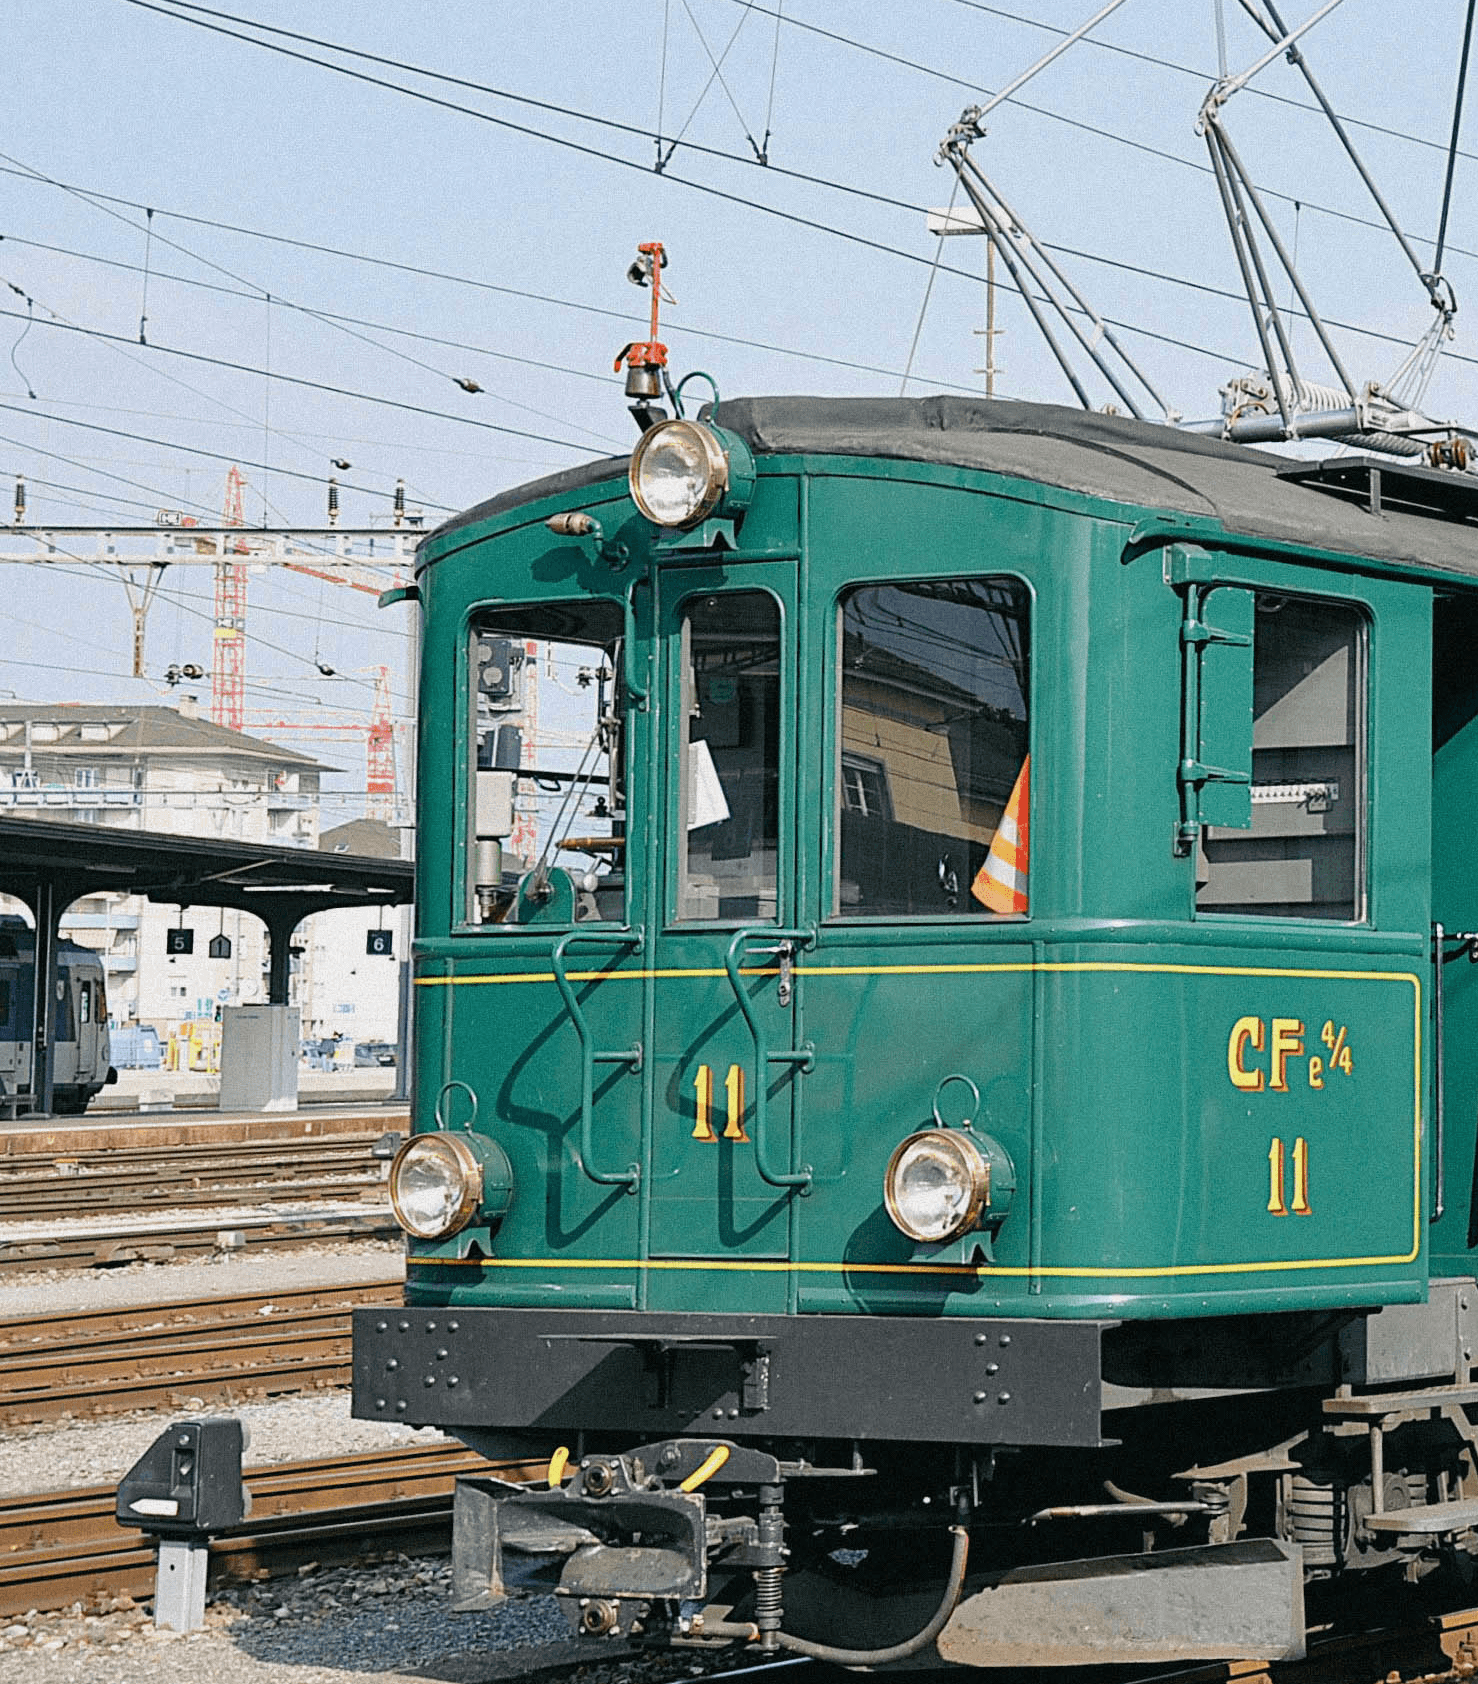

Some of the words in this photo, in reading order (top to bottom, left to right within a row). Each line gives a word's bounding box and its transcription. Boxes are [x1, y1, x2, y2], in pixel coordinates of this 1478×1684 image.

[174, 936, 185, 950] 5
[373, 937, 385, 951] 6
[692, 1064, 751, 1143] 11
[1267, 1137, 1312, 1216] 11
